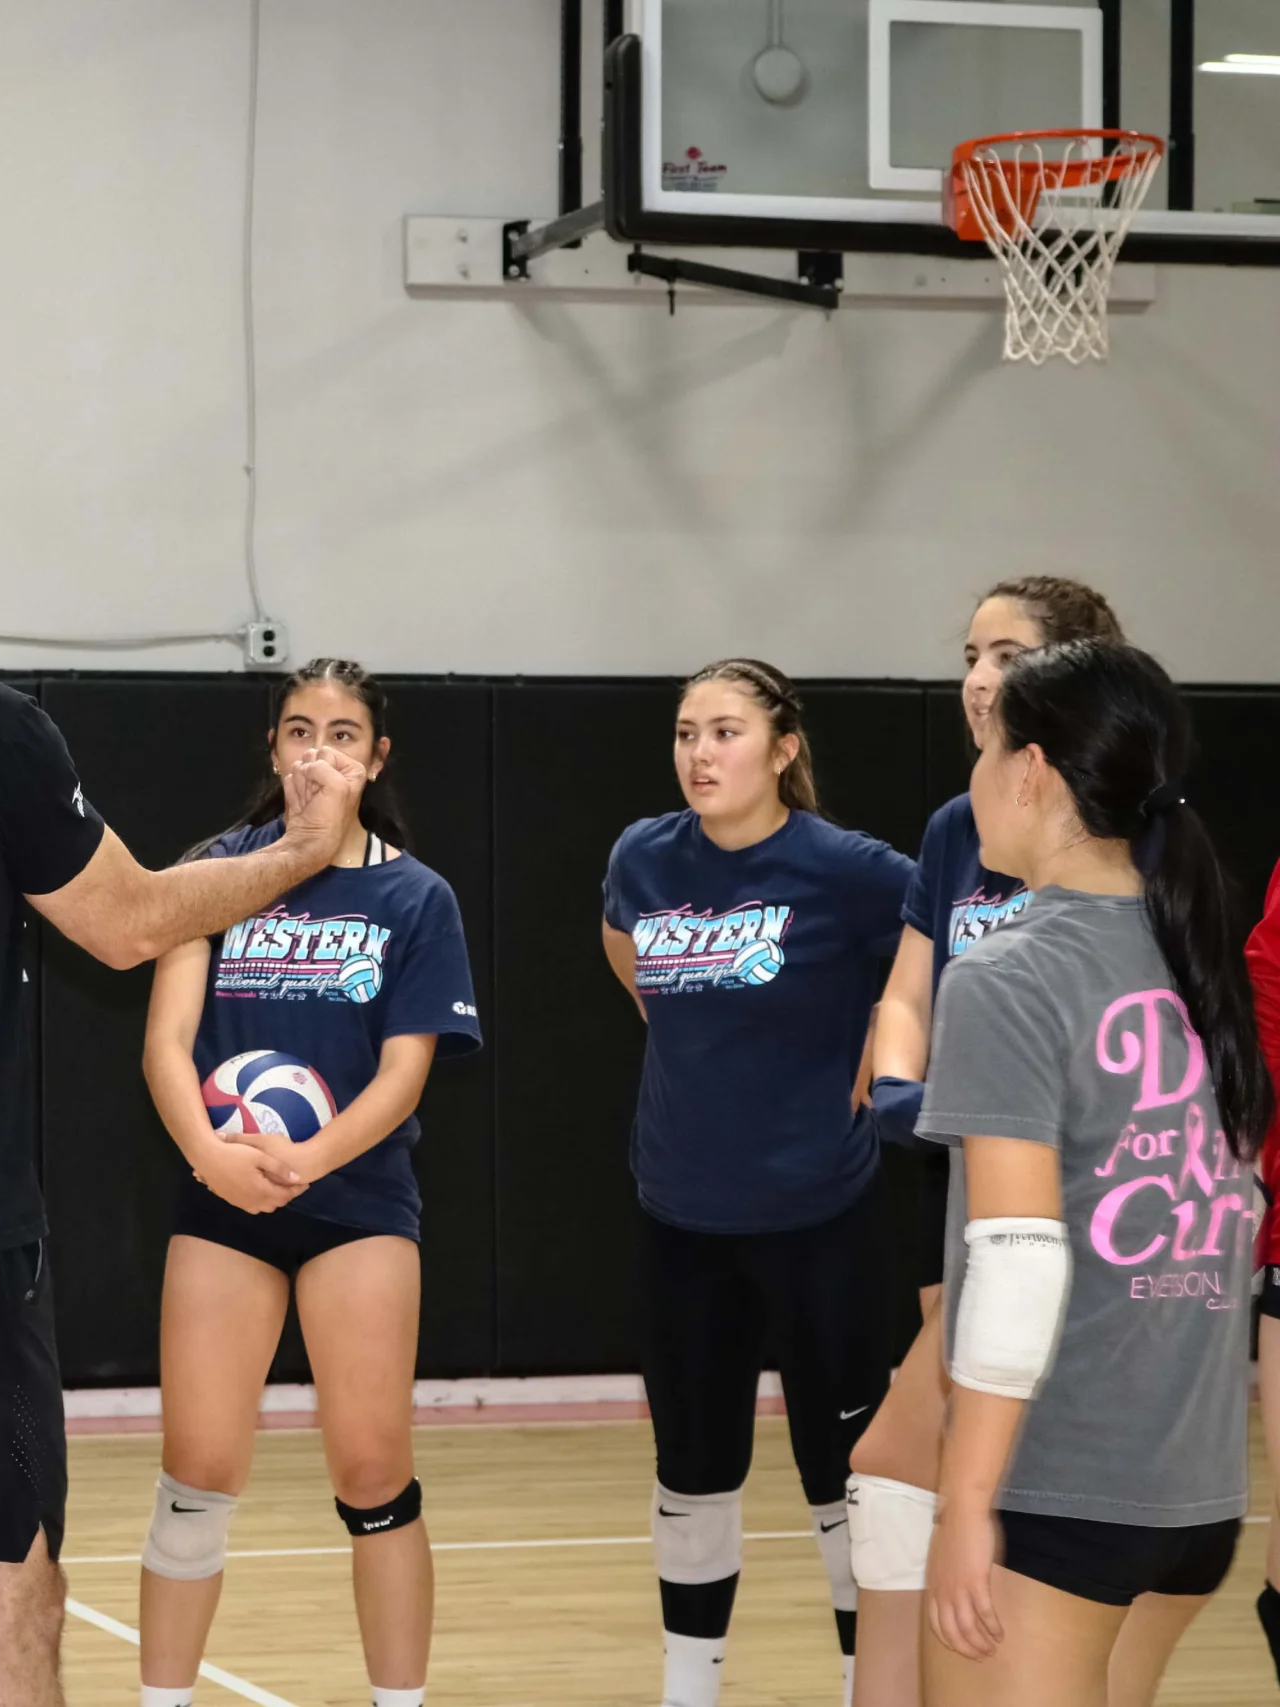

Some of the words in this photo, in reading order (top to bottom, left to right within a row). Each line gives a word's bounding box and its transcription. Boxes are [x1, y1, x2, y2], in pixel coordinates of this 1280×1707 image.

[221, 917, 391, 965] WESTERN
[632, 906, 792, 957] WESTERN
[1094, 1123, 1180, 1177] for
